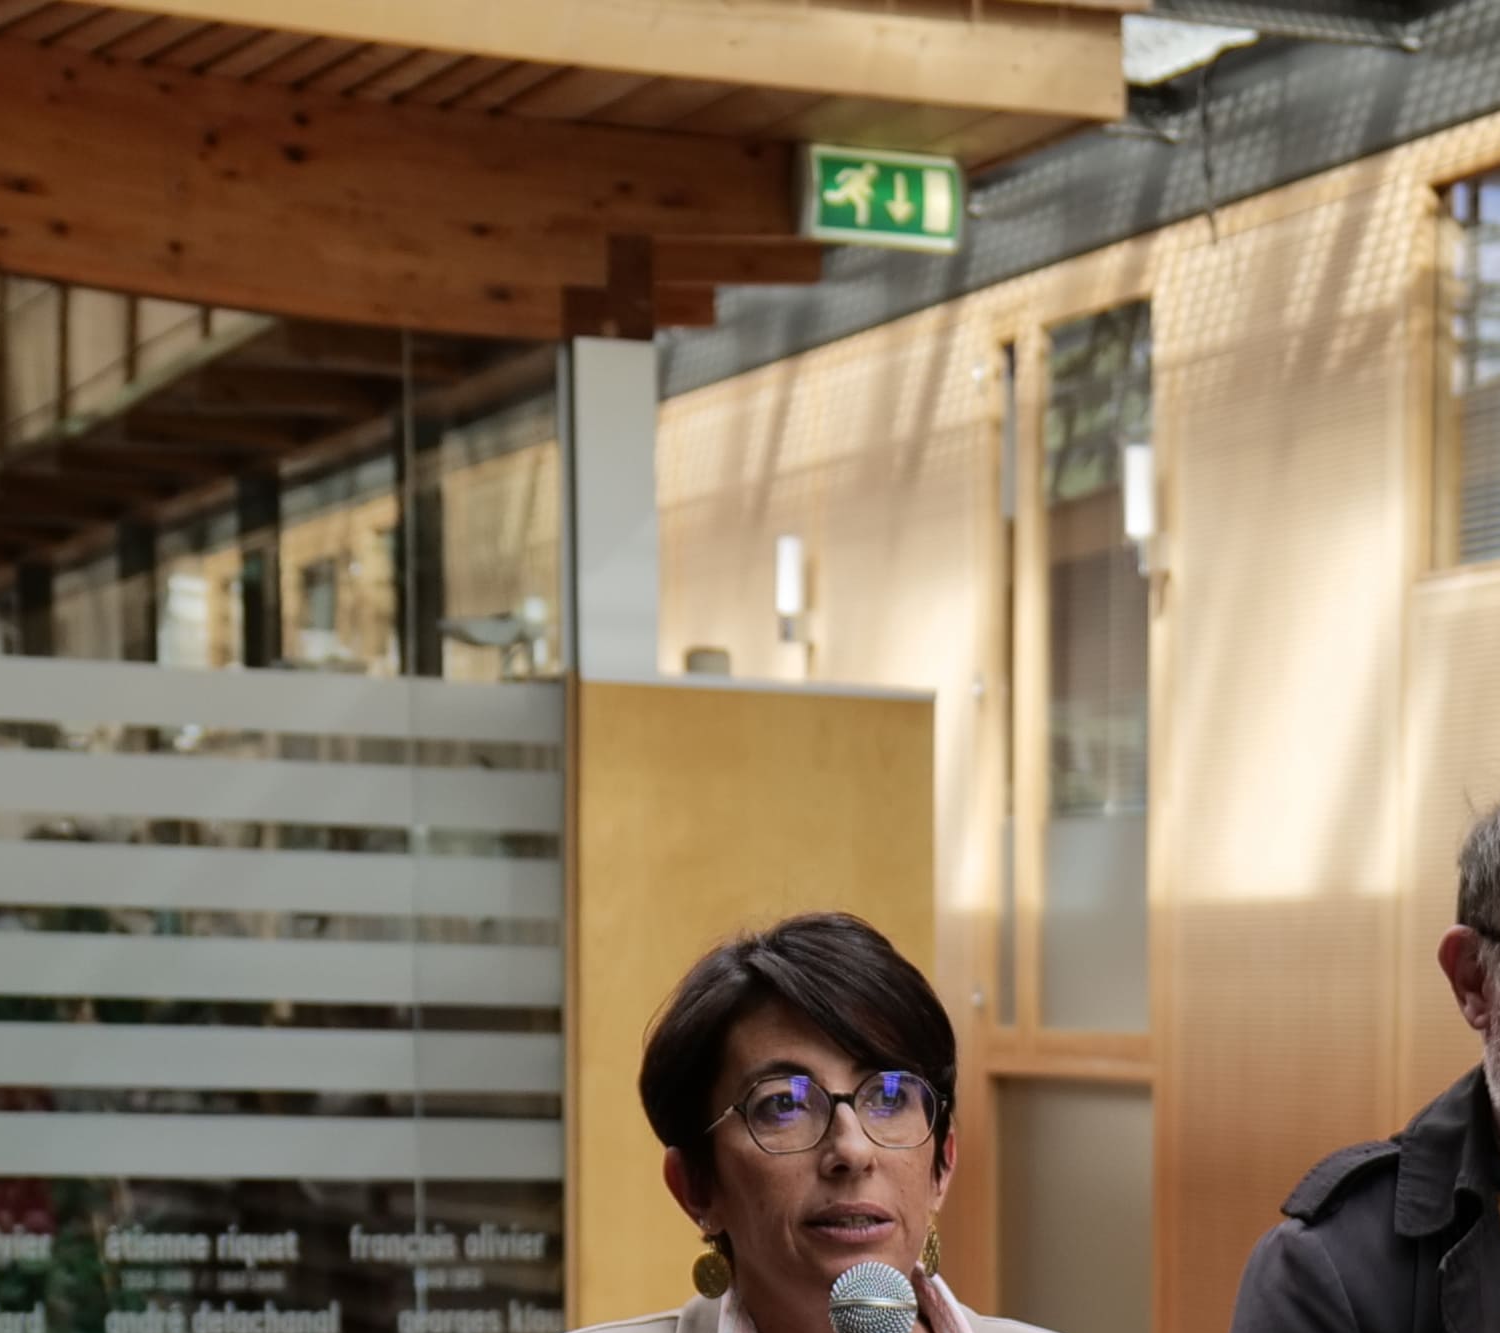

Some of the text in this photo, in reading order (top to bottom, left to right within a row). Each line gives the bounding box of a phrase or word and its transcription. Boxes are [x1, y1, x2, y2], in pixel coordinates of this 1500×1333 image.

[104, 1223, 299, 1270] étienne riquet
[350, 1222, 547, 1265] françois olivier
